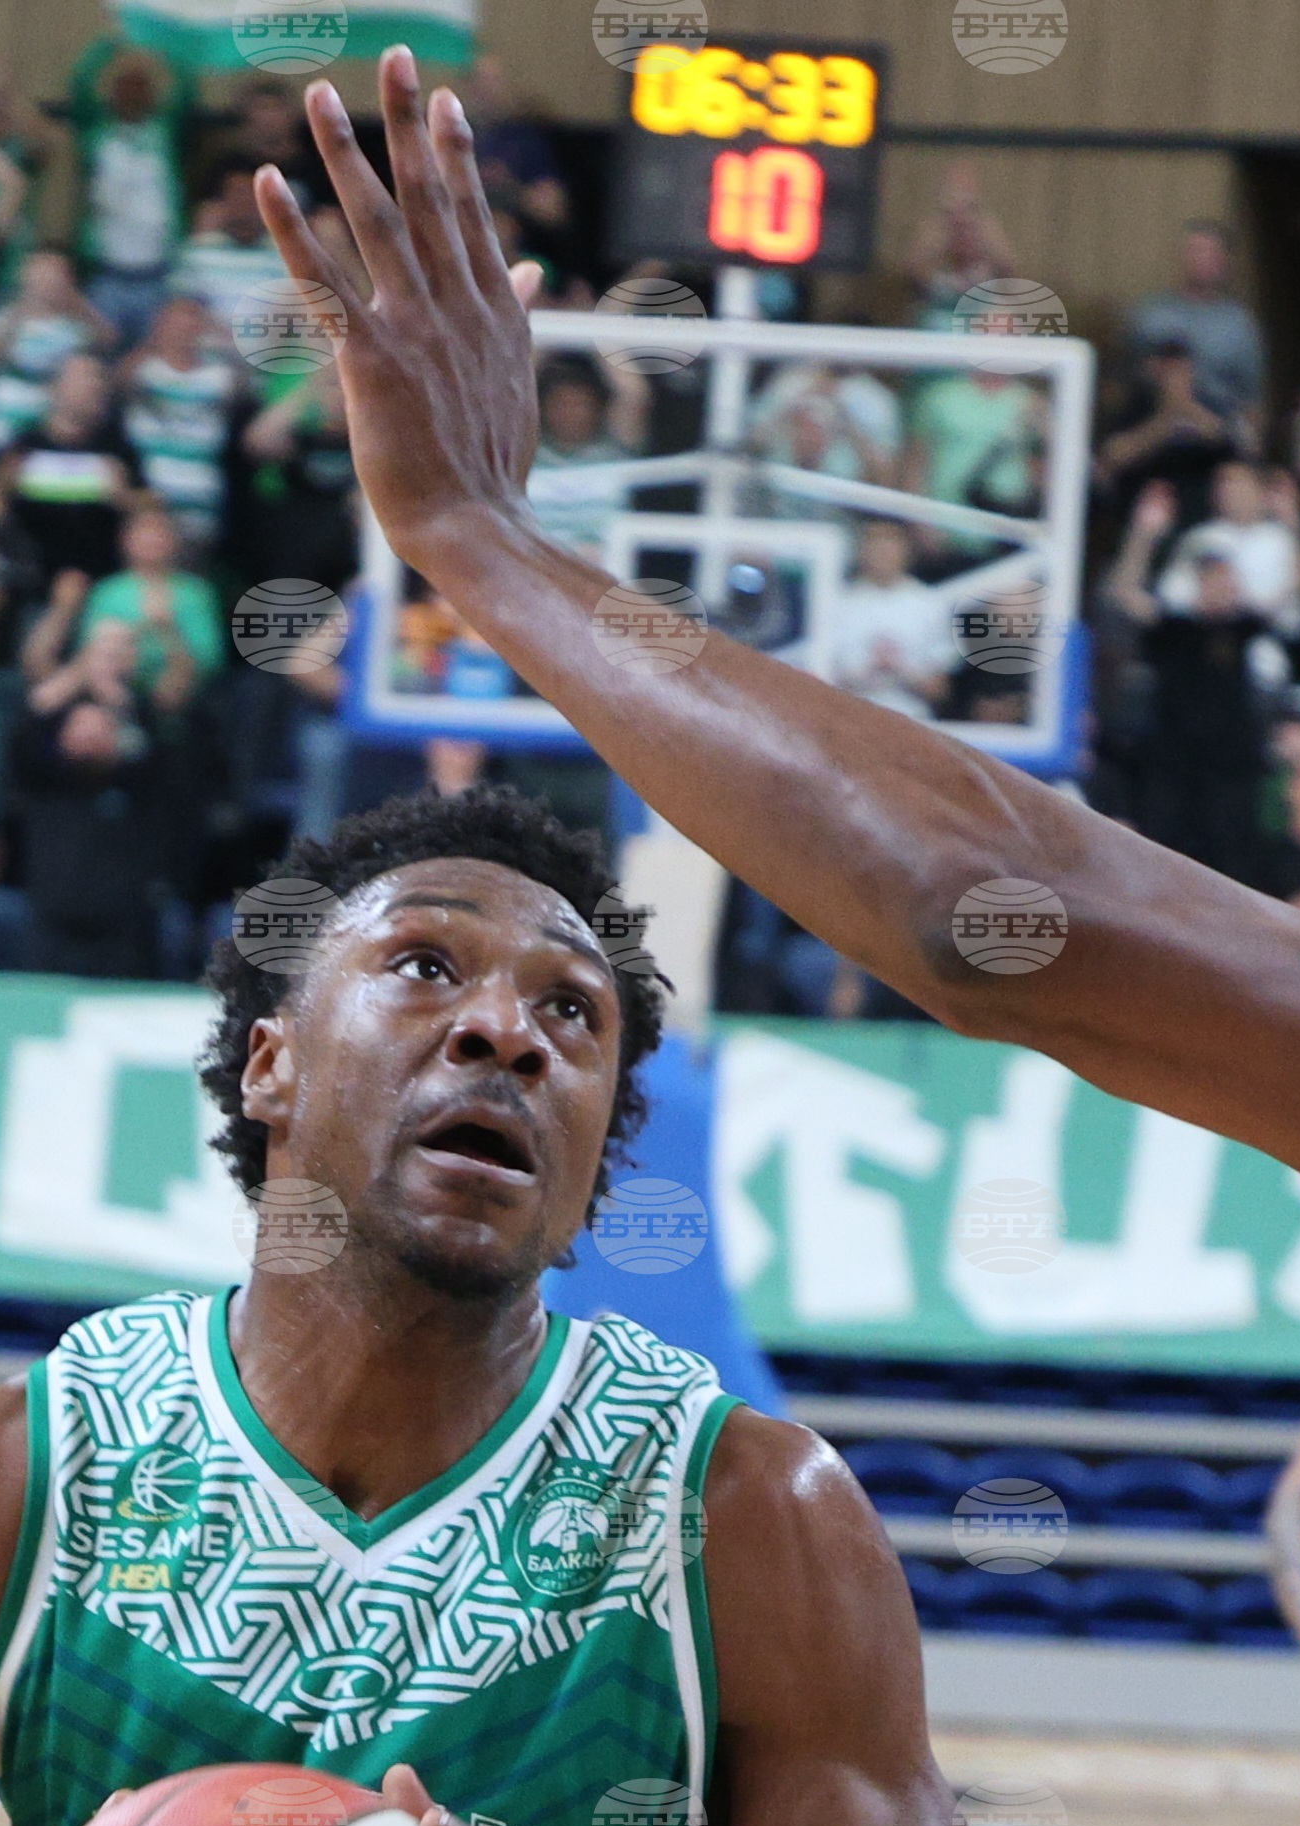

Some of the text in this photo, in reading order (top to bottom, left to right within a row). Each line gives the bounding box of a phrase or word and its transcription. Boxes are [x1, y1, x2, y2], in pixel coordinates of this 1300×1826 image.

[631, 43, 879, 148] 06:33
[708, 146, 825, 264] 10
[69, 1521, 230, 1560] SESAME
[527, 1551, 606, 1574] БАЛКАН
